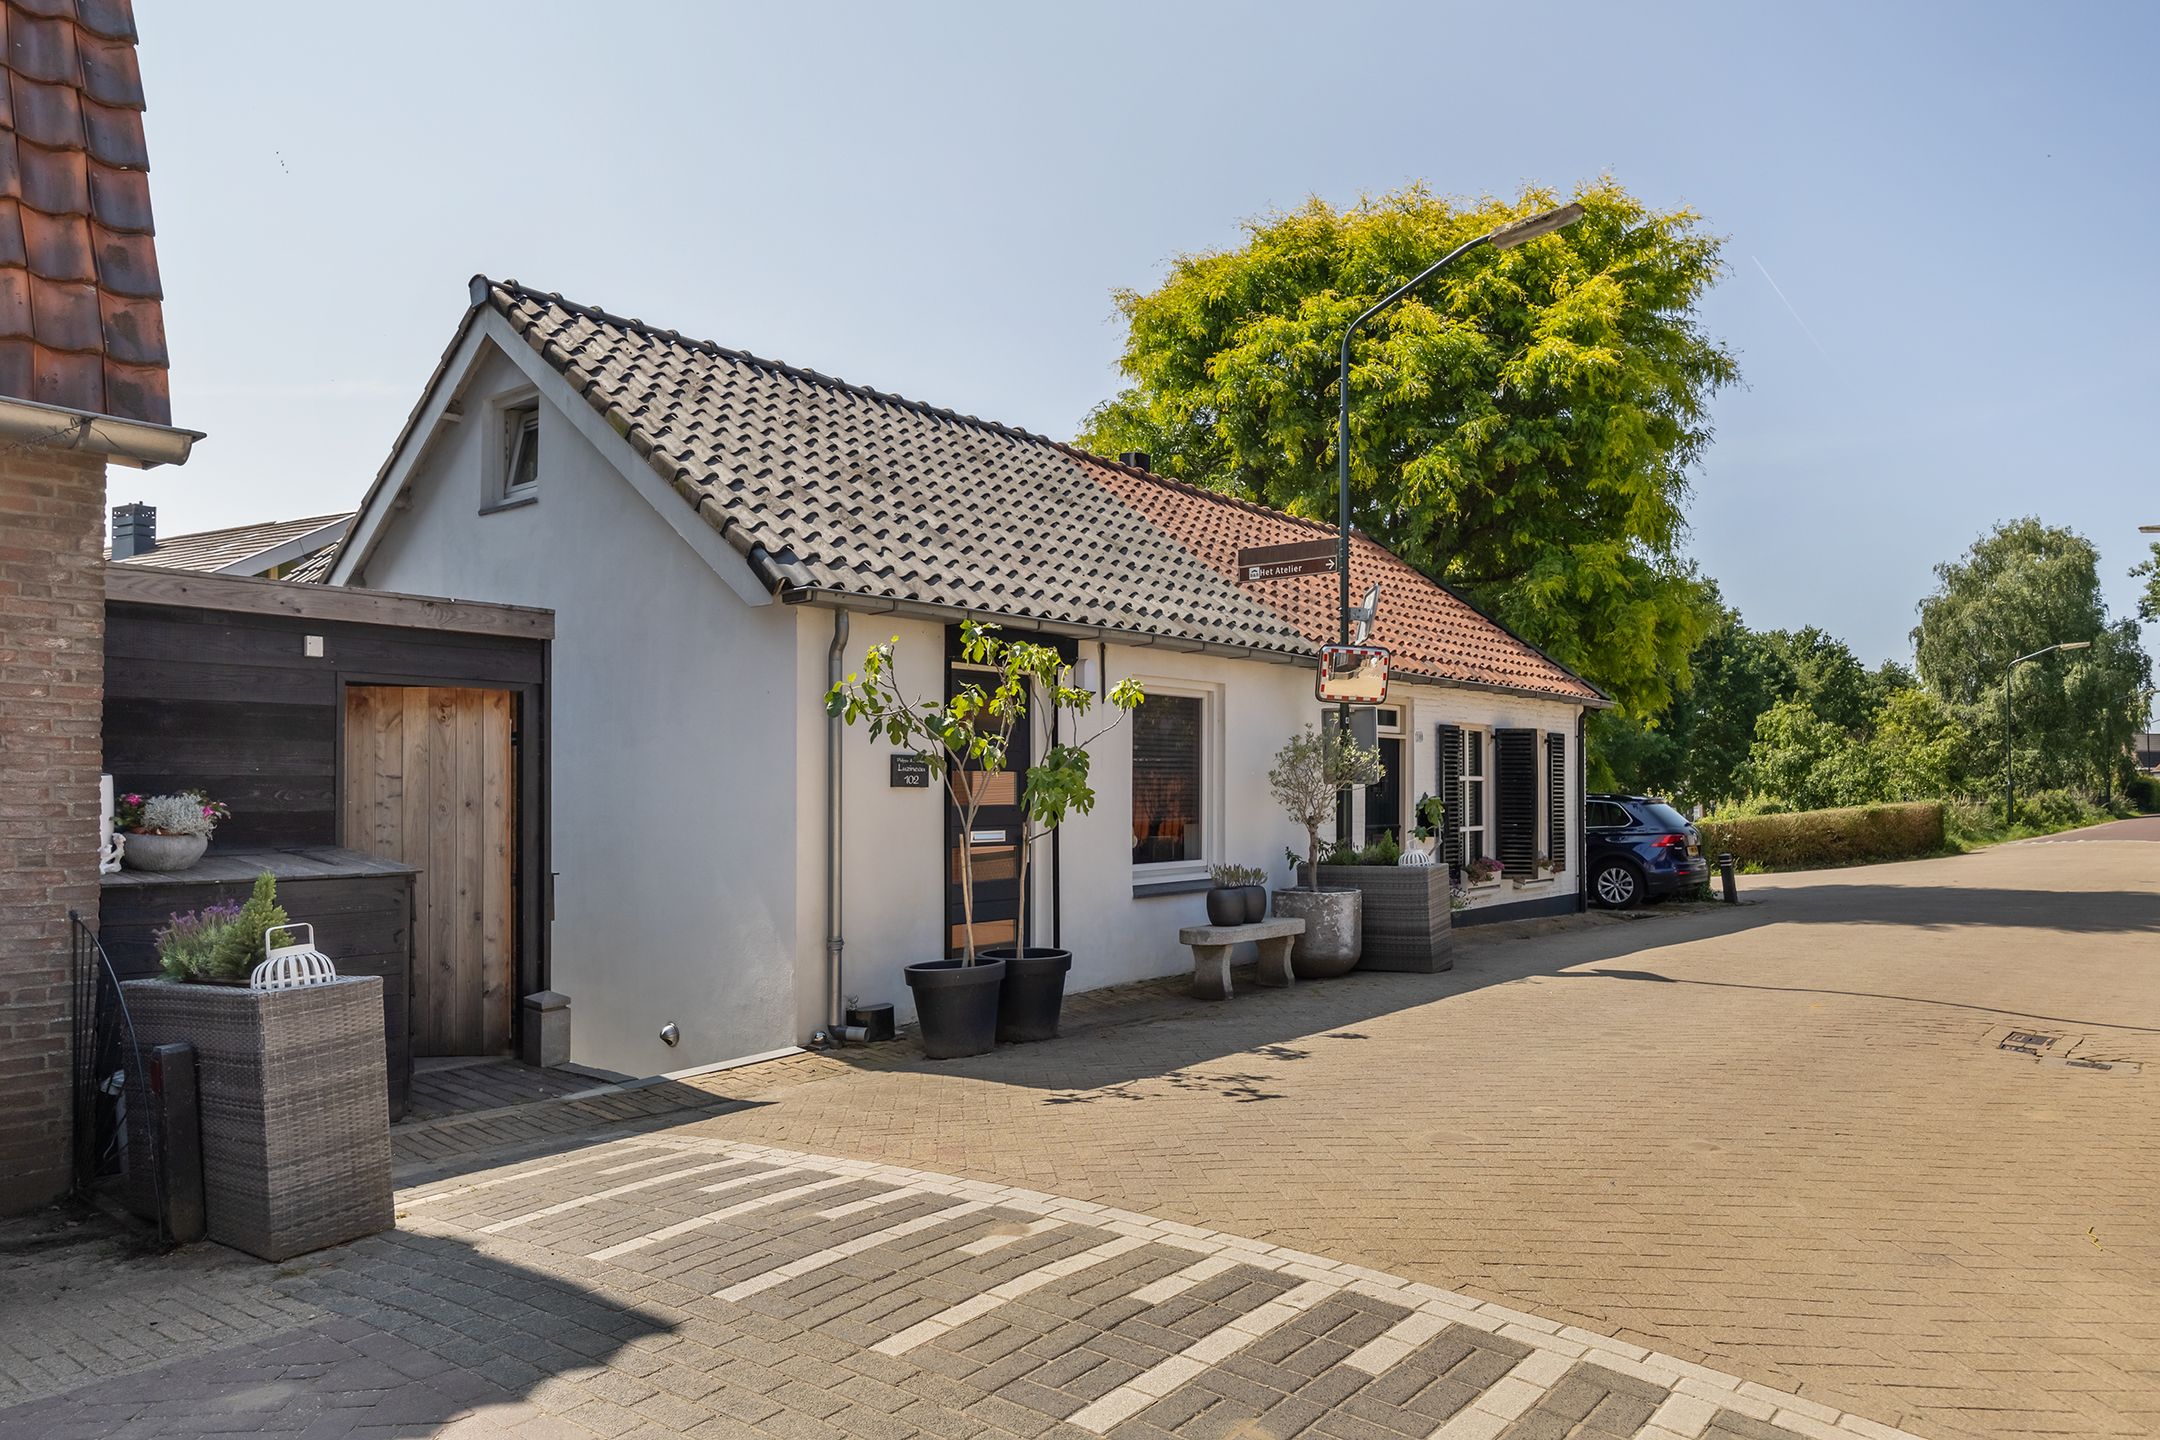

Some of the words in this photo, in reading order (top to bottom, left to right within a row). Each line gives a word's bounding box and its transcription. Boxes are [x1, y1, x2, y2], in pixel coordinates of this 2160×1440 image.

[1260, 567, 1273, 577] Het
[1275, 565, 1302, 575] Atelier
[904, 775, 919, 785] 102
